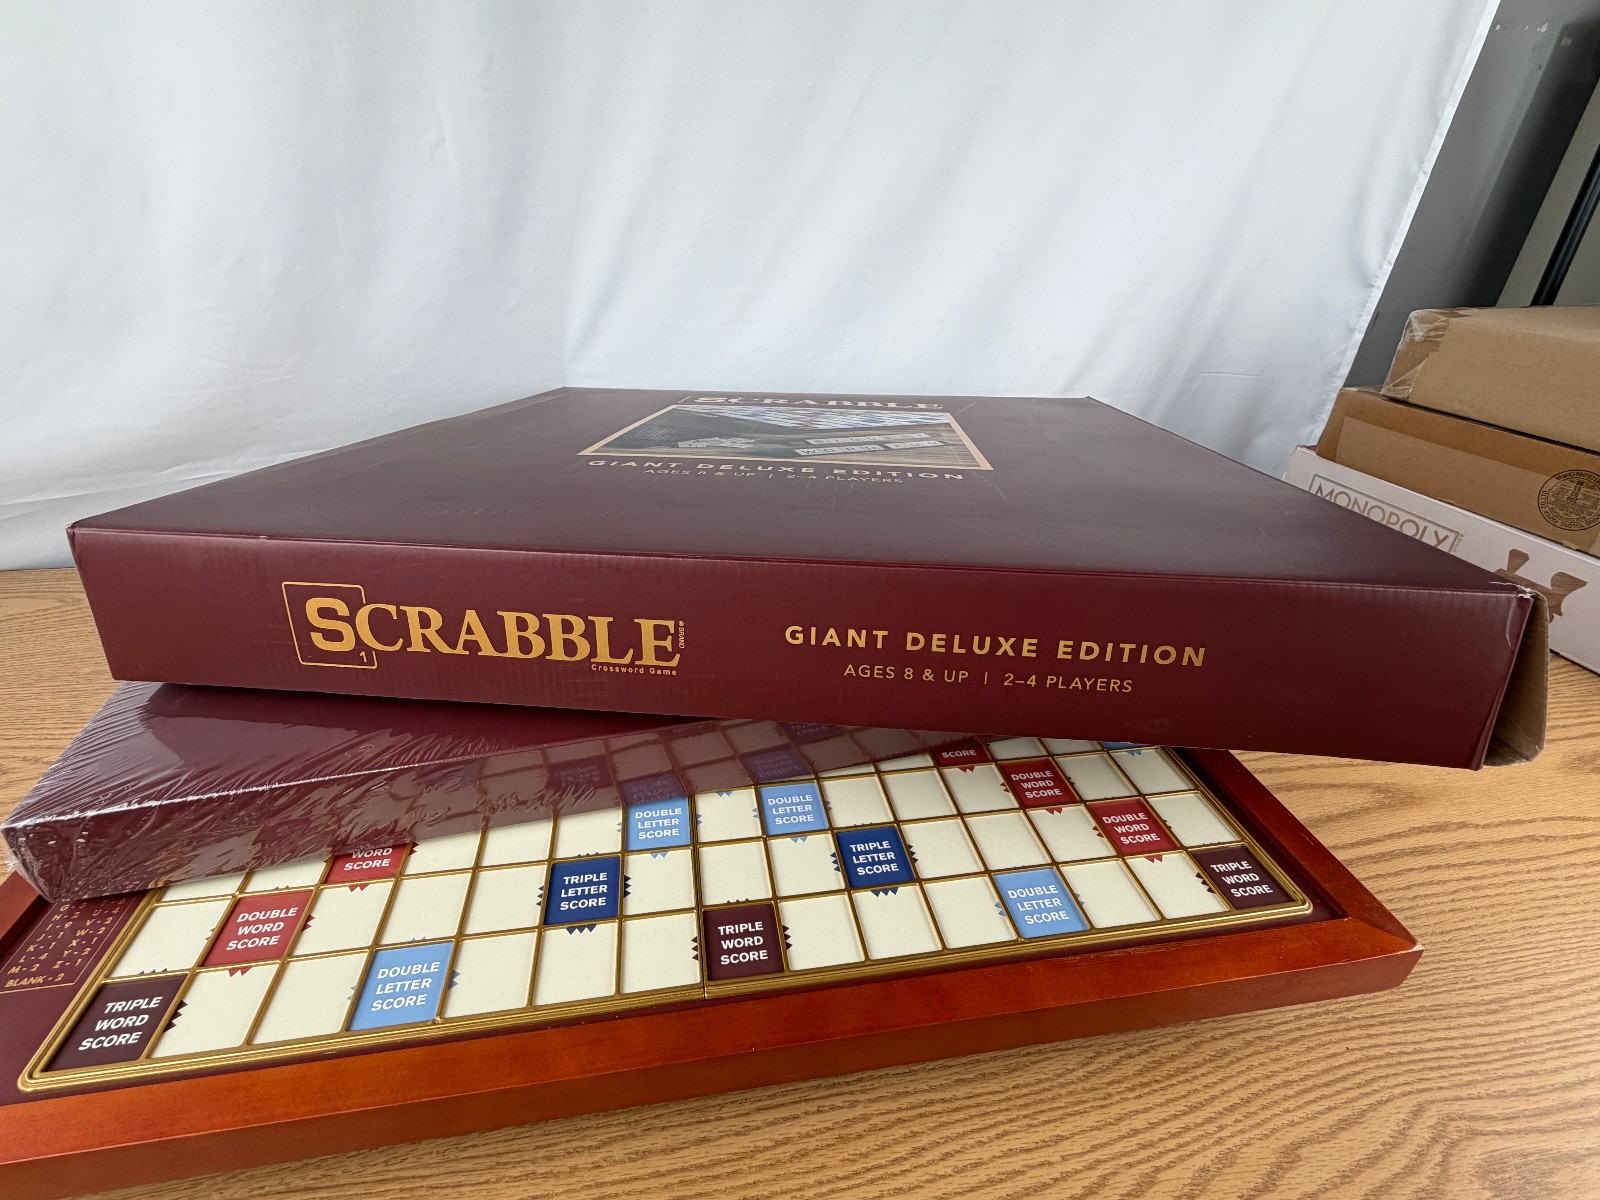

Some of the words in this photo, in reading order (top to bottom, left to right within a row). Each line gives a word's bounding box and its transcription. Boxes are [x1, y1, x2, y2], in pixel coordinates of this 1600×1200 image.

[588, 460, 682, 468] GIANT
[696, 464, 814, 473] DELUXE
[833, 469, 963, 480] EDITION
[305, 597, 681, 667] SCRABBLE
[785, 626, 889, 649] GIANT
[906, 632, 1038, 658] DELUXE
[1057, 640, 1206, 667] EDITION
[590, 664, 645, 674] Crossword
[650, 667, 677, 676] Game
[844, 664, 895, 678] AGES
[904, 668, 914, 680] 8
[922, 669, 934, 682] &
[944, 670, 969, 683] UP
[1046, 676, 1132, 693] PLAYERS
[942, 748, 977, 759] SCORE
[1011, 770, 1054, 782] DOUBLE
[1020, 778, 1054, 790] WORD
[768, 794, 813, 805] DOUBLE
[1025, 787, 1063, 799] SCORE
[635, 808, 682, 819] DOUBLE
[773, 804, 813, 815] LETTER
[637, 818, 679, 828] LETTER
[775, 814, 814, 825] SCORE
[1102, 812, 1148, 825] DOUBLE
[638, 828, 679, 839] SCORE
[1114, 821, 1150, 834] WORD
[1120, 832, 1160, 845] SCORE
[849, 840, 891, 852] TRIPLE
[352, 848, 393, 858] WORD
[852, 852, 896, 864] LETTER
[344, 859, 391, 870] SCORE
[856, 862, 899, 875] SCORE
[1210, 860, 1252, 874] TRIPLE
[563, 872, 608, 885] TRIPLE
[1222, 871, 1260, 885] WORD
[561, 884, 608, 897] LETTER
[1008, 884, 1059, 899] DOUBLE
[1230, 883, 1273, 898] SCORE
[560, 897, 606, 910] SCORE
[1016, 898, 1063, 911] LETTER
[236, 907, 299, 923] DOUBLE
[1025, 910, 1069, 925] SCORE
[237, 921, 285, 936] WORD
[718, 921, 764, 935] TRIPLE
[226, 935, 281, 951] SCORE
[721, 935, 764, 949] WORD
[720, 950, 768, 965] SCORE
[377, 962, 440, 979] DOUBLE
[4, 976, 47, 987] BLANK
[375, 979, 433, 995] LETTER
[104, 997, 163, 1014] TRIPLE
[370, 994, 428, 1012] SCORE
[95, 1014, 150, 1032] WORD
[78, 1031, 143, 1051] SCORE
